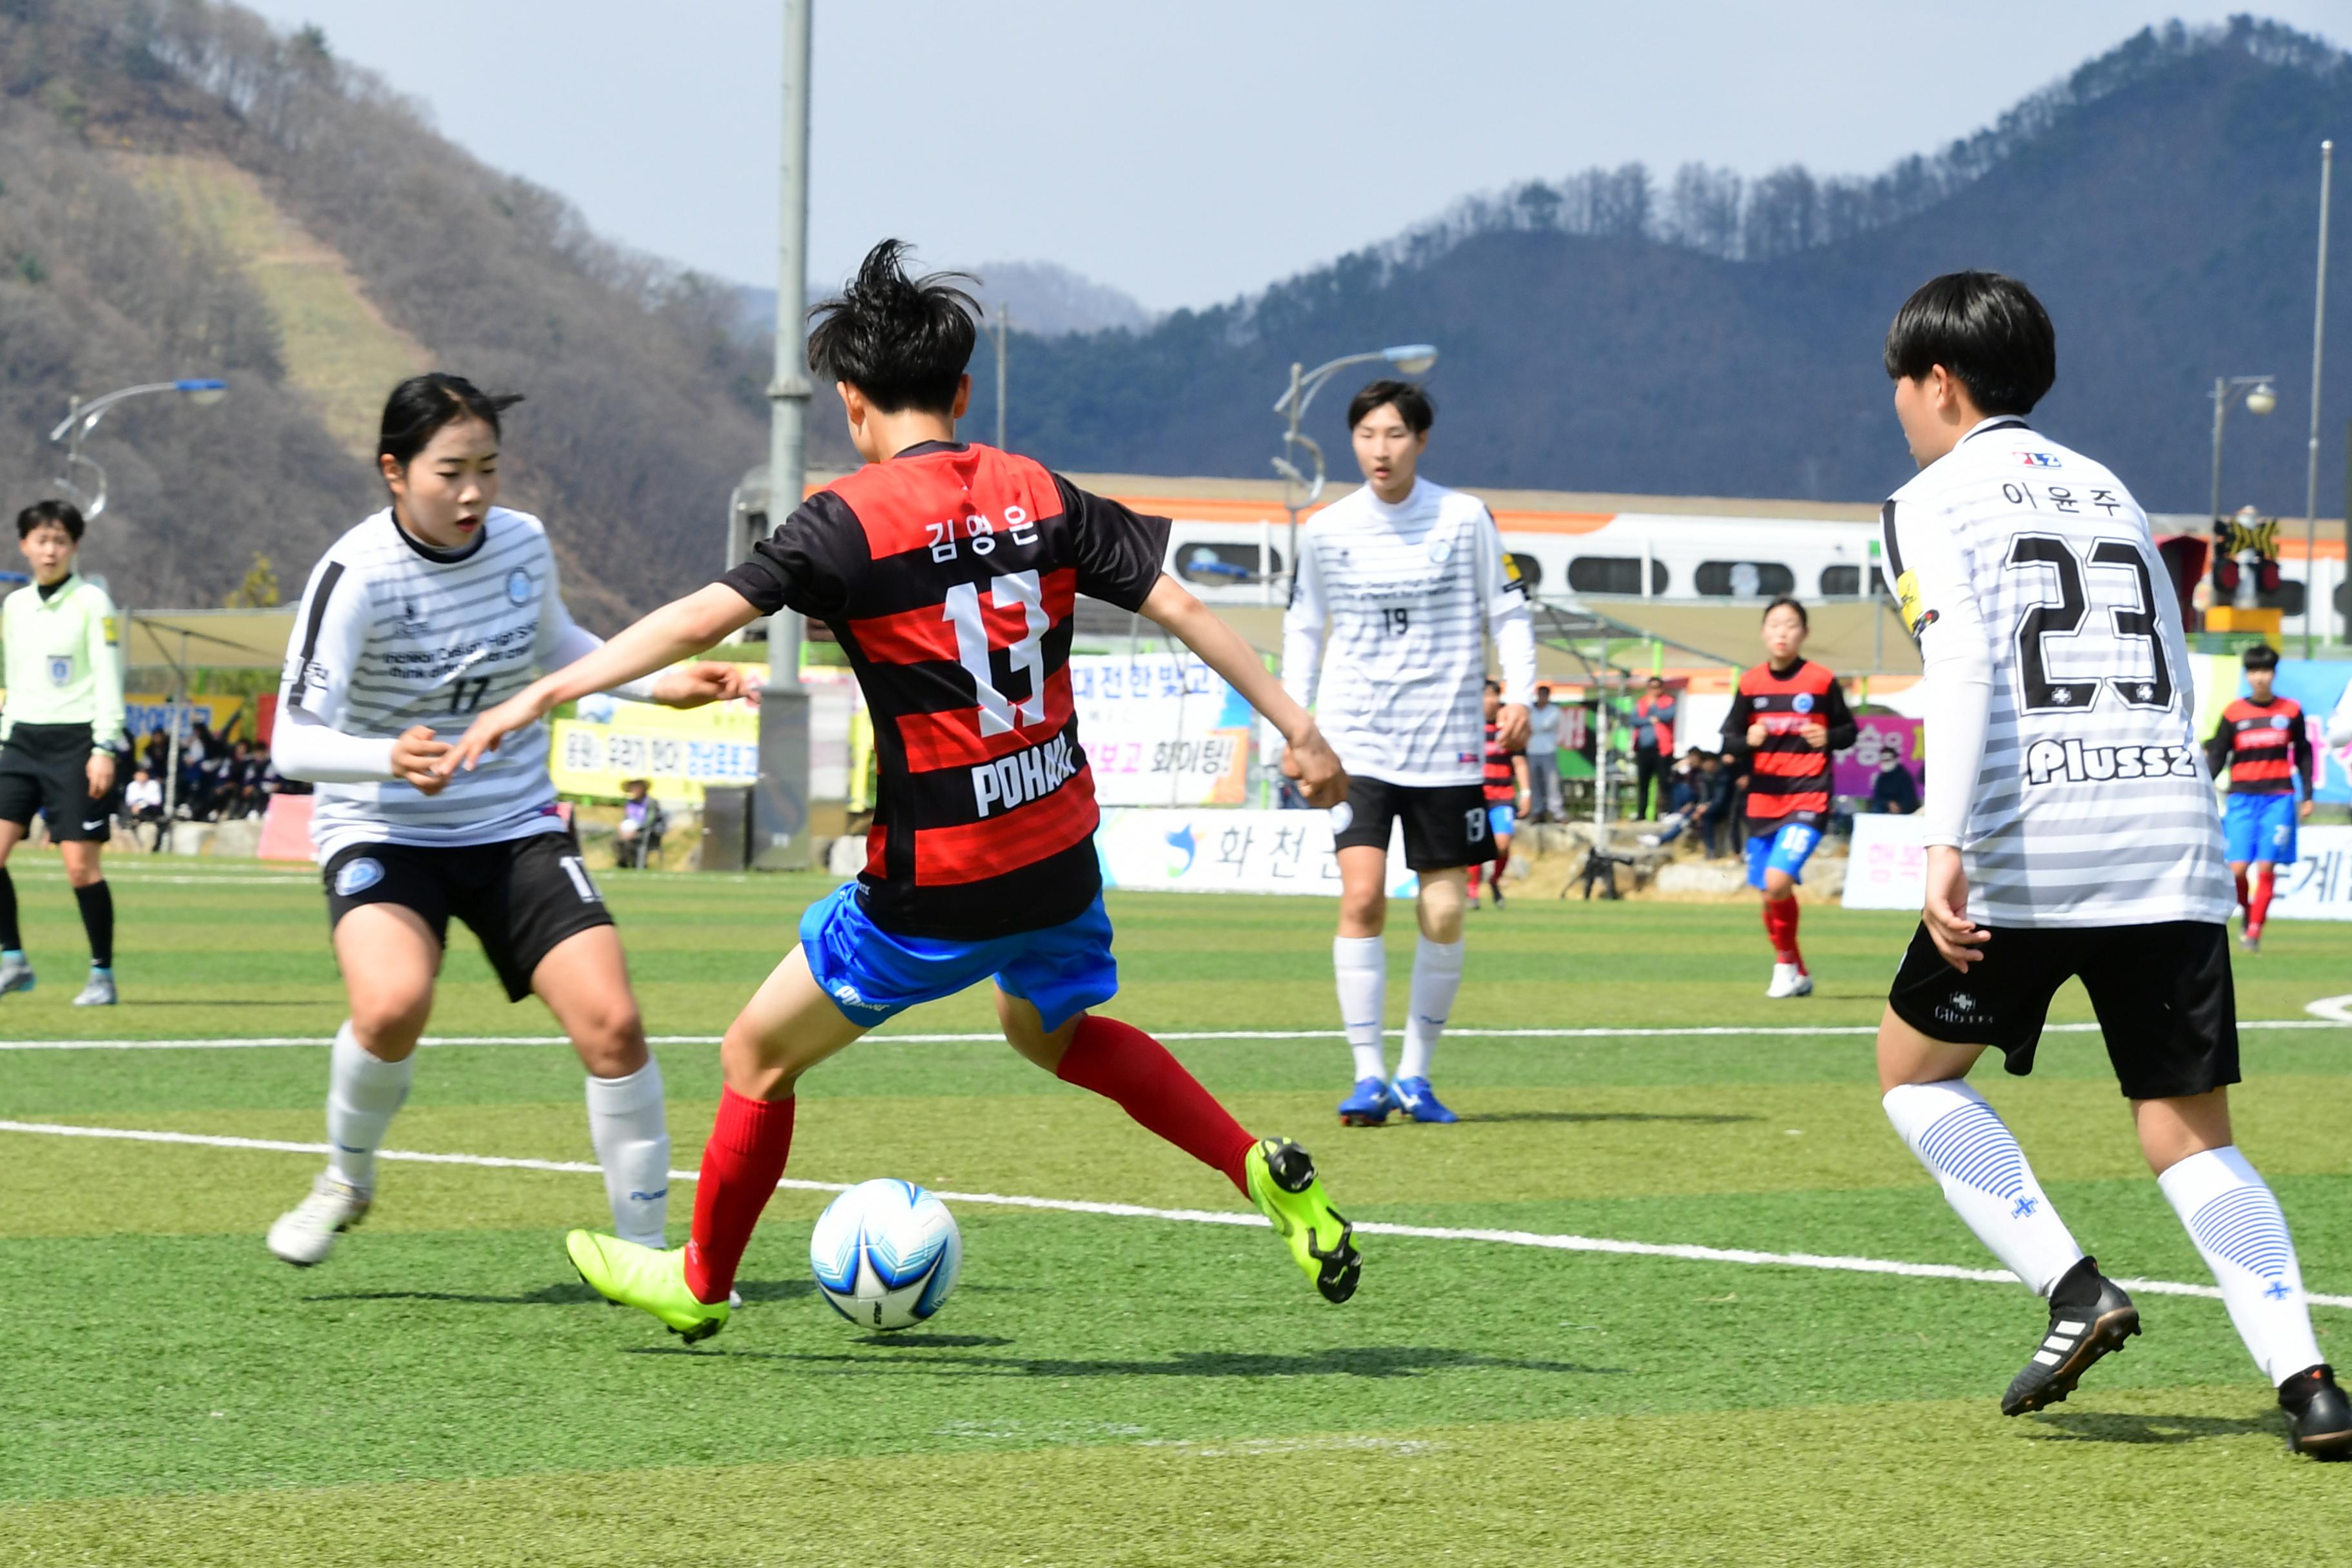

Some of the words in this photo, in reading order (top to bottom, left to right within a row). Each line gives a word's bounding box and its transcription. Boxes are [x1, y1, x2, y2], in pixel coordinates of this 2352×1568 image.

[2003, 482, 2121, 516] 이윤주
[925, 505, 1038, 563] 김영은
[1383, 608, 1409, 636] 19
[2005, 531, 2177, 717] 23
[942, 569, 1050, 738] 13
[450, 677, 490, 713] 17
